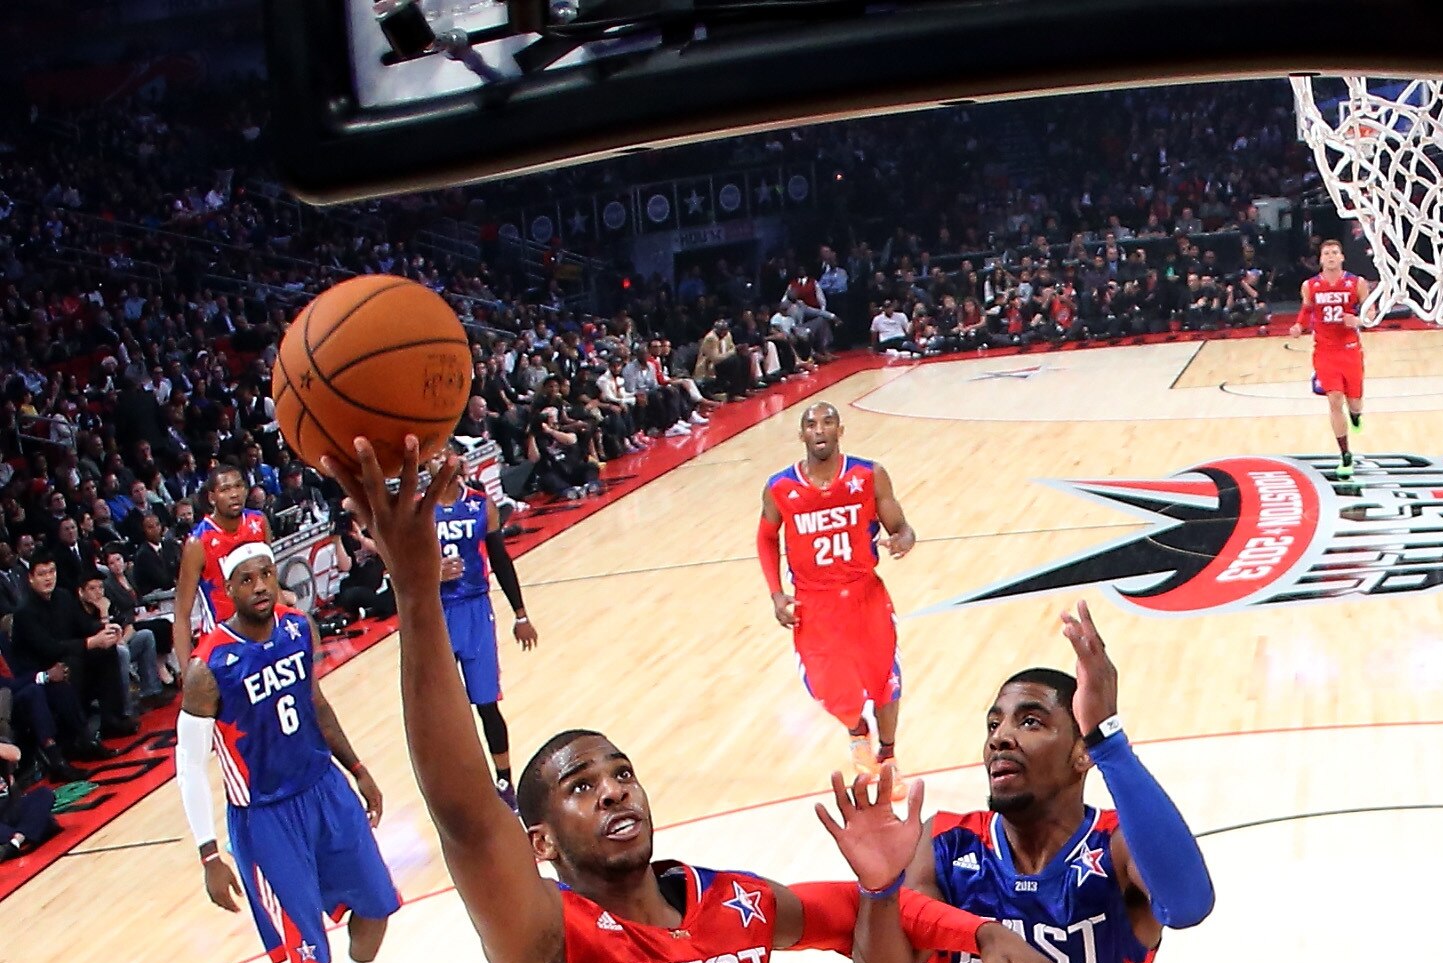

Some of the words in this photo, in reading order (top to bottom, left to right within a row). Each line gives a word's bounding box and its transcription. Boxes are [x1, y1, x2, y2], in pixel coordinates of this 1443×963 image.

[1315, 291, 1351, 304] WEST
[1323, 305, 1344, 322] 32
[1247, 470, 1302, 528] HOUSTON
[437, 519, 477, 540] AST
[794, 503, 863, 534] WEST
[813, 531, 852, 566] 24
[1216, 535, 1295, 582] 2013
[244, 651, 306, 704] EAST
[277, 695, 300, 736] 6
[1014, 880, 1038, 892] 2013
